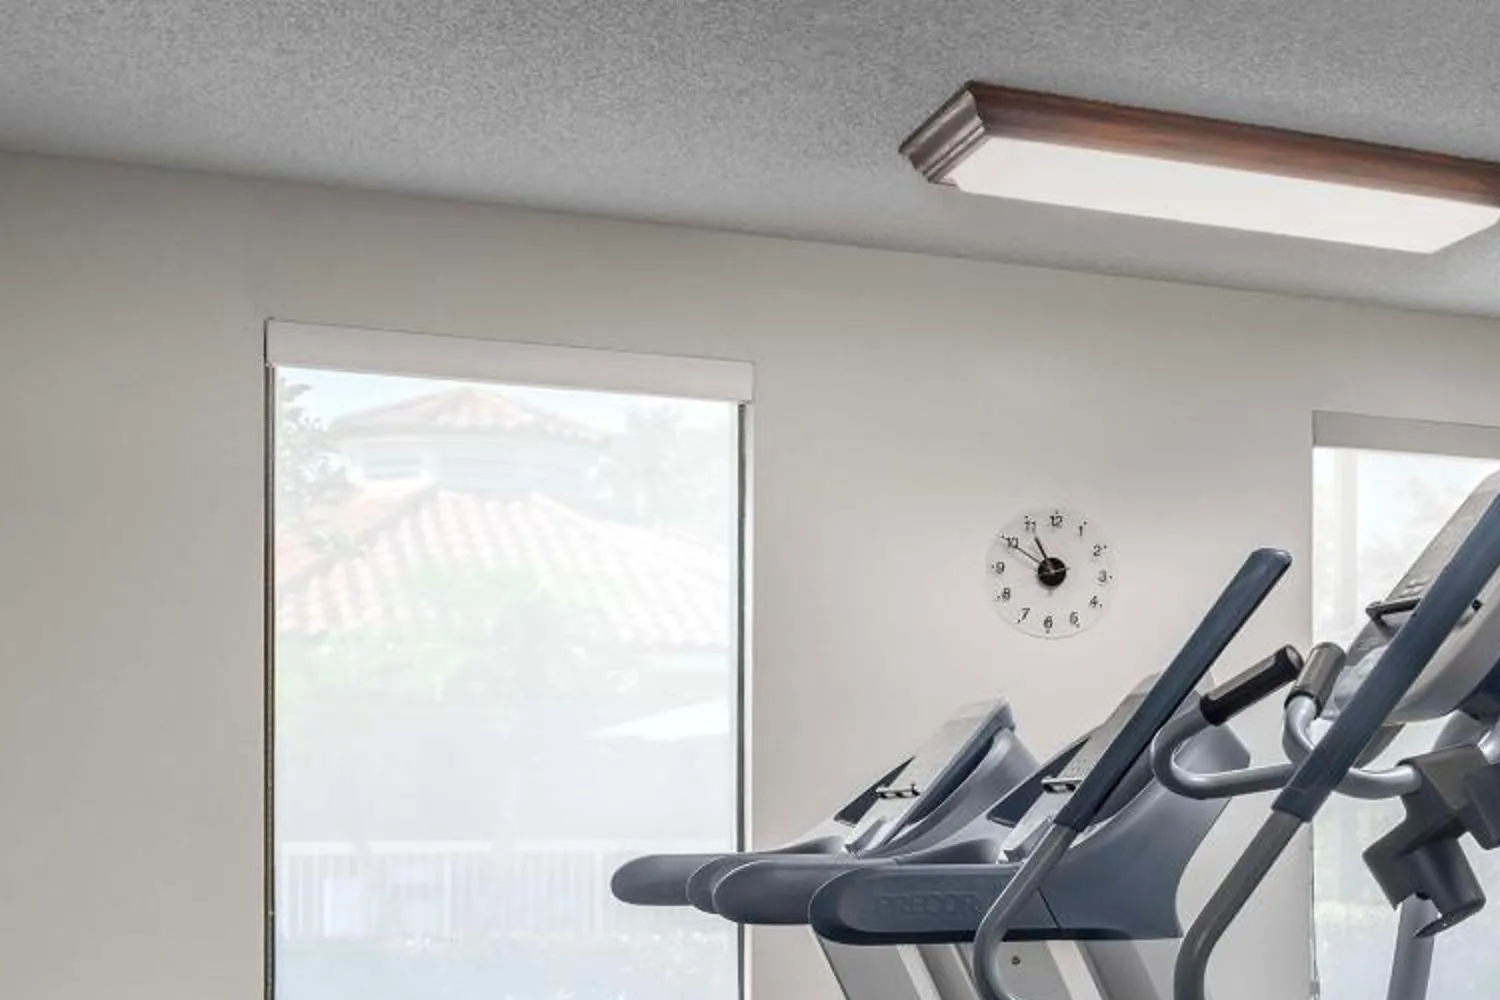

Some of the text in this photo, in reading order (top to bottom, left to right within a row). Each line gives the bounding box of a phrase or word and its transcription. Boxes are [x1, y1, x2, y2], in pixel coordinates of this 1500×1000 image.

[1050, 515, 1063, 528] 12
[1093, 544, 1101, 556] 2
[995, 561, 1005, 574] 9
[1002, 587, 1011, 600] 8
[1089, 595, 1098, 608] 4
[1021, 607, 1031, 620] 7
[1043, 616, 1053, 629] 6
